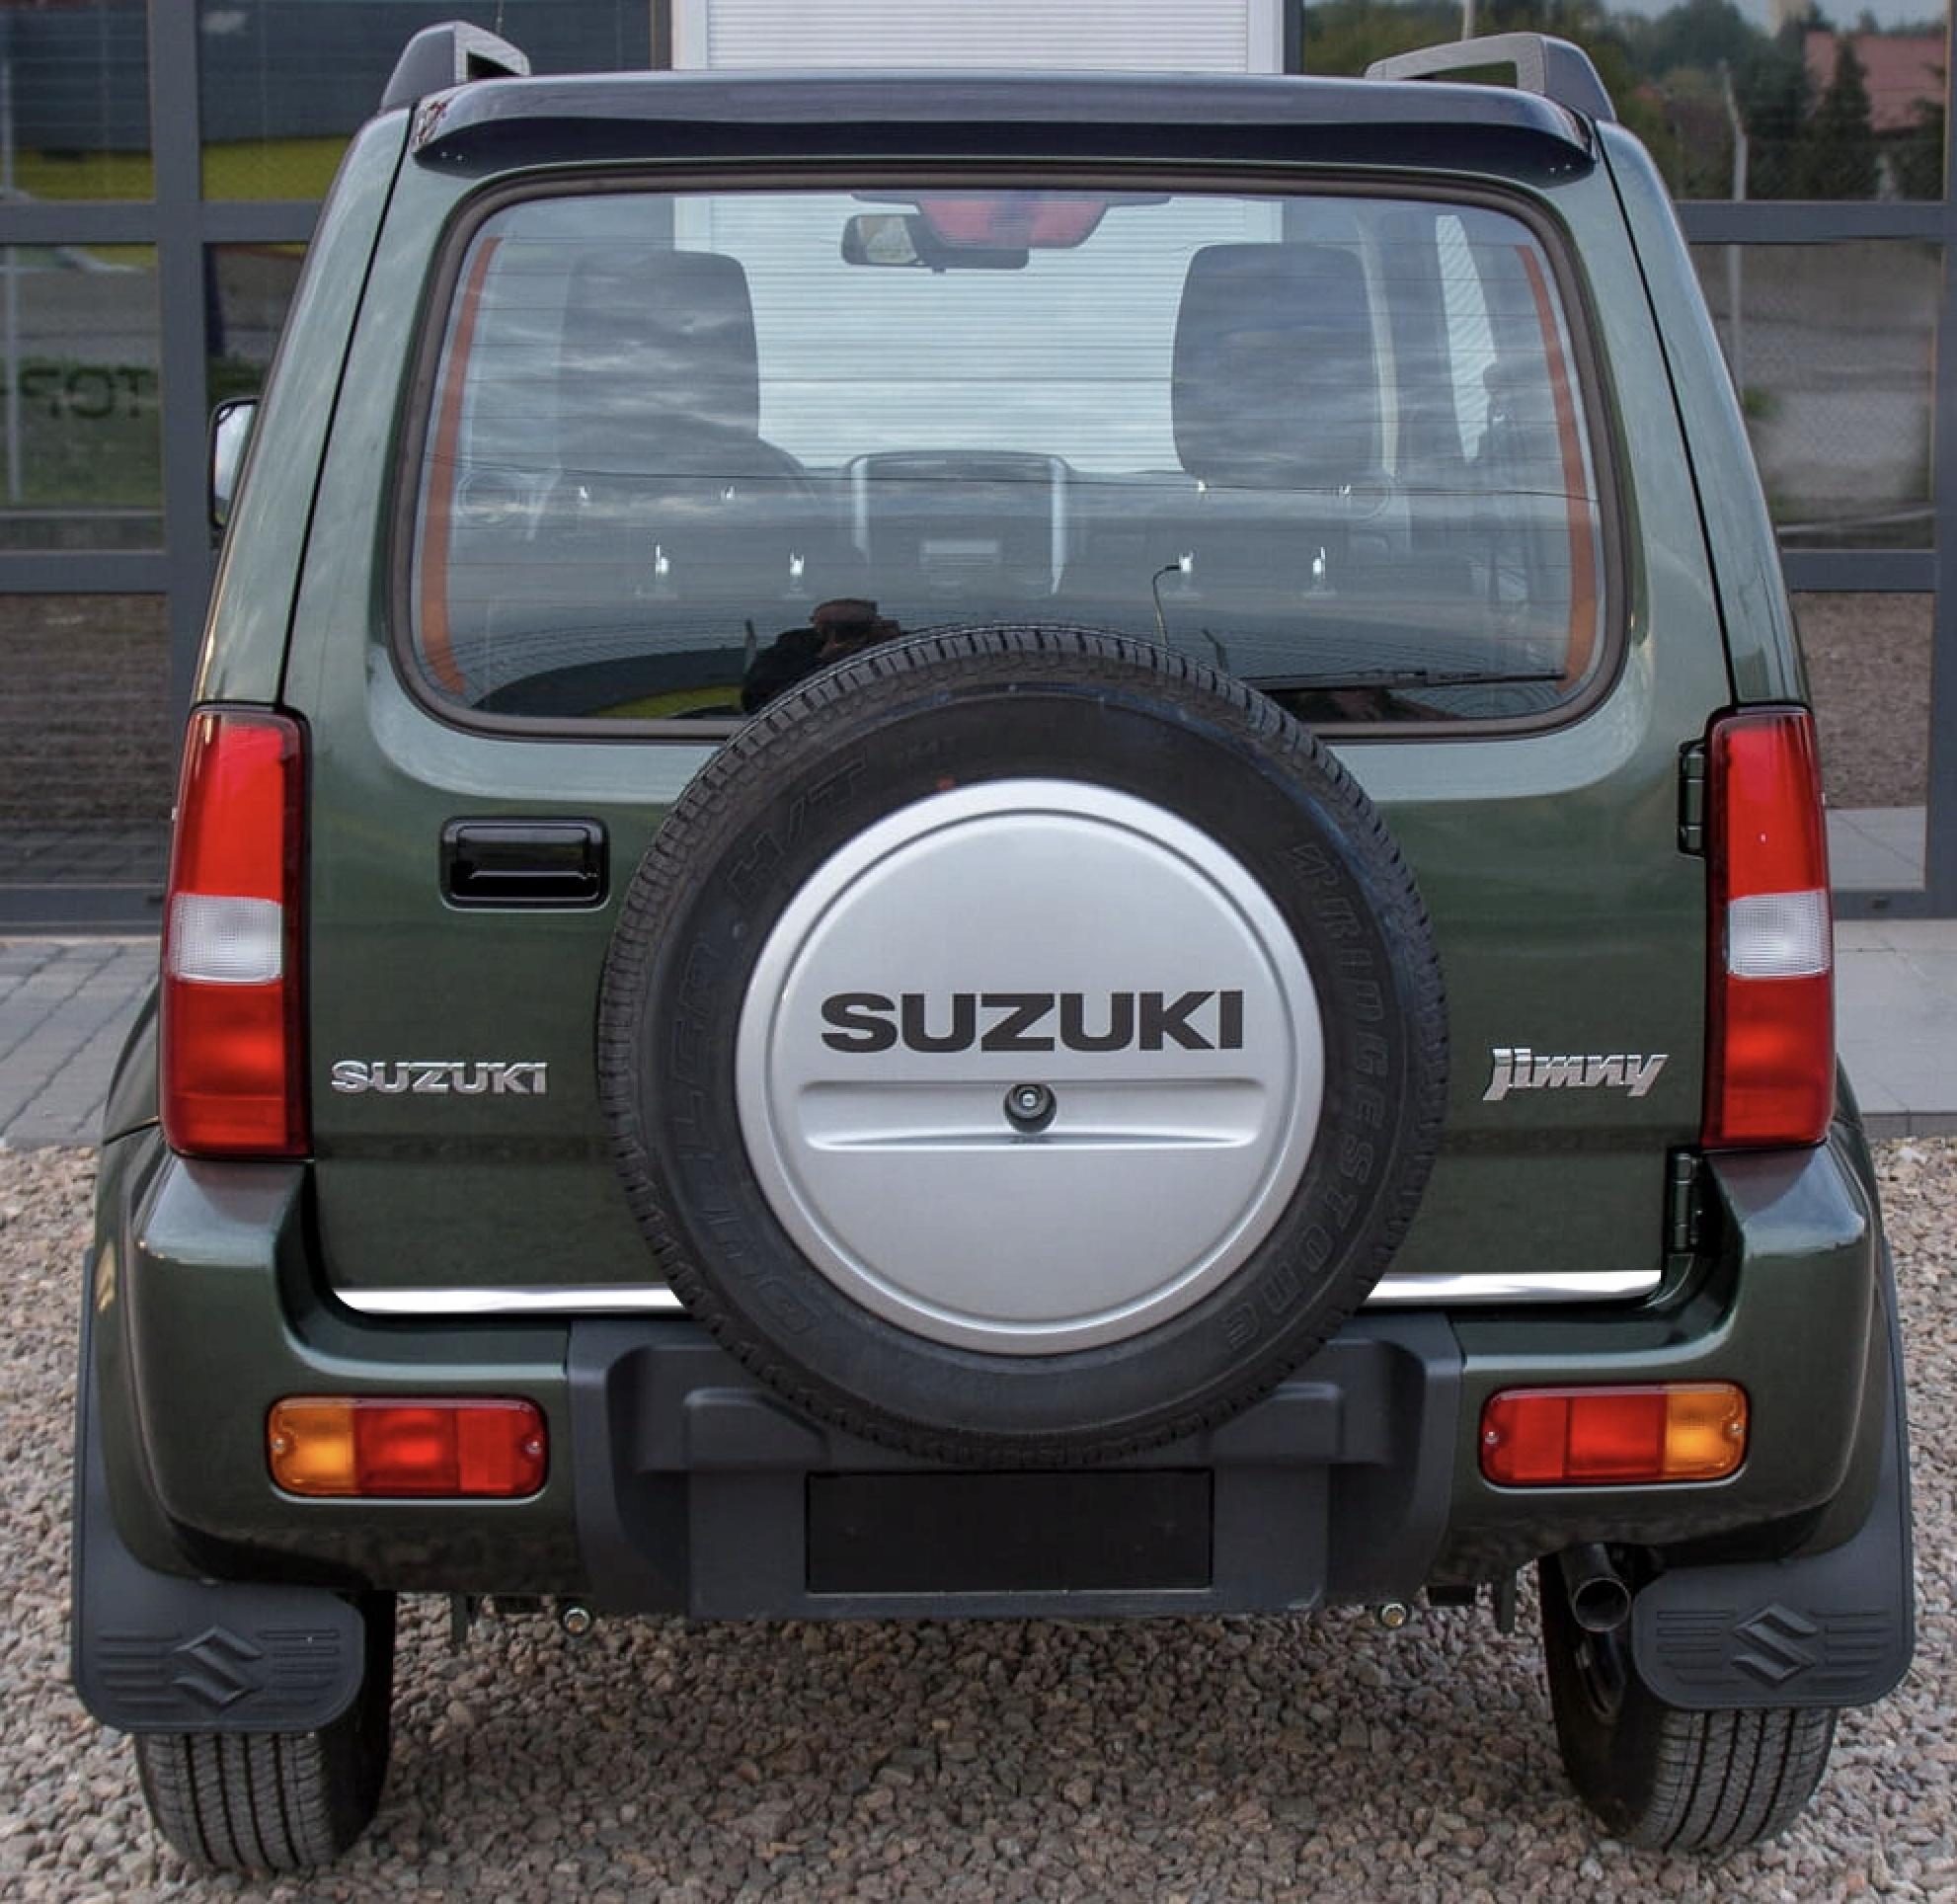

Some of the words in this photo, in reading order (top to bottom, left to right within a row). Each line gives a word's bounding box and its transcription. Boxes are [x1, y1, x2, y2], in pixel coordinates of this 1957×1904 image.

[822, 990, 1243, 1053] SUZUKI
[331, 1060, 547, 1094] SUZUKI
[1223, 843, 1390, 1344] BRIDGESTONE
